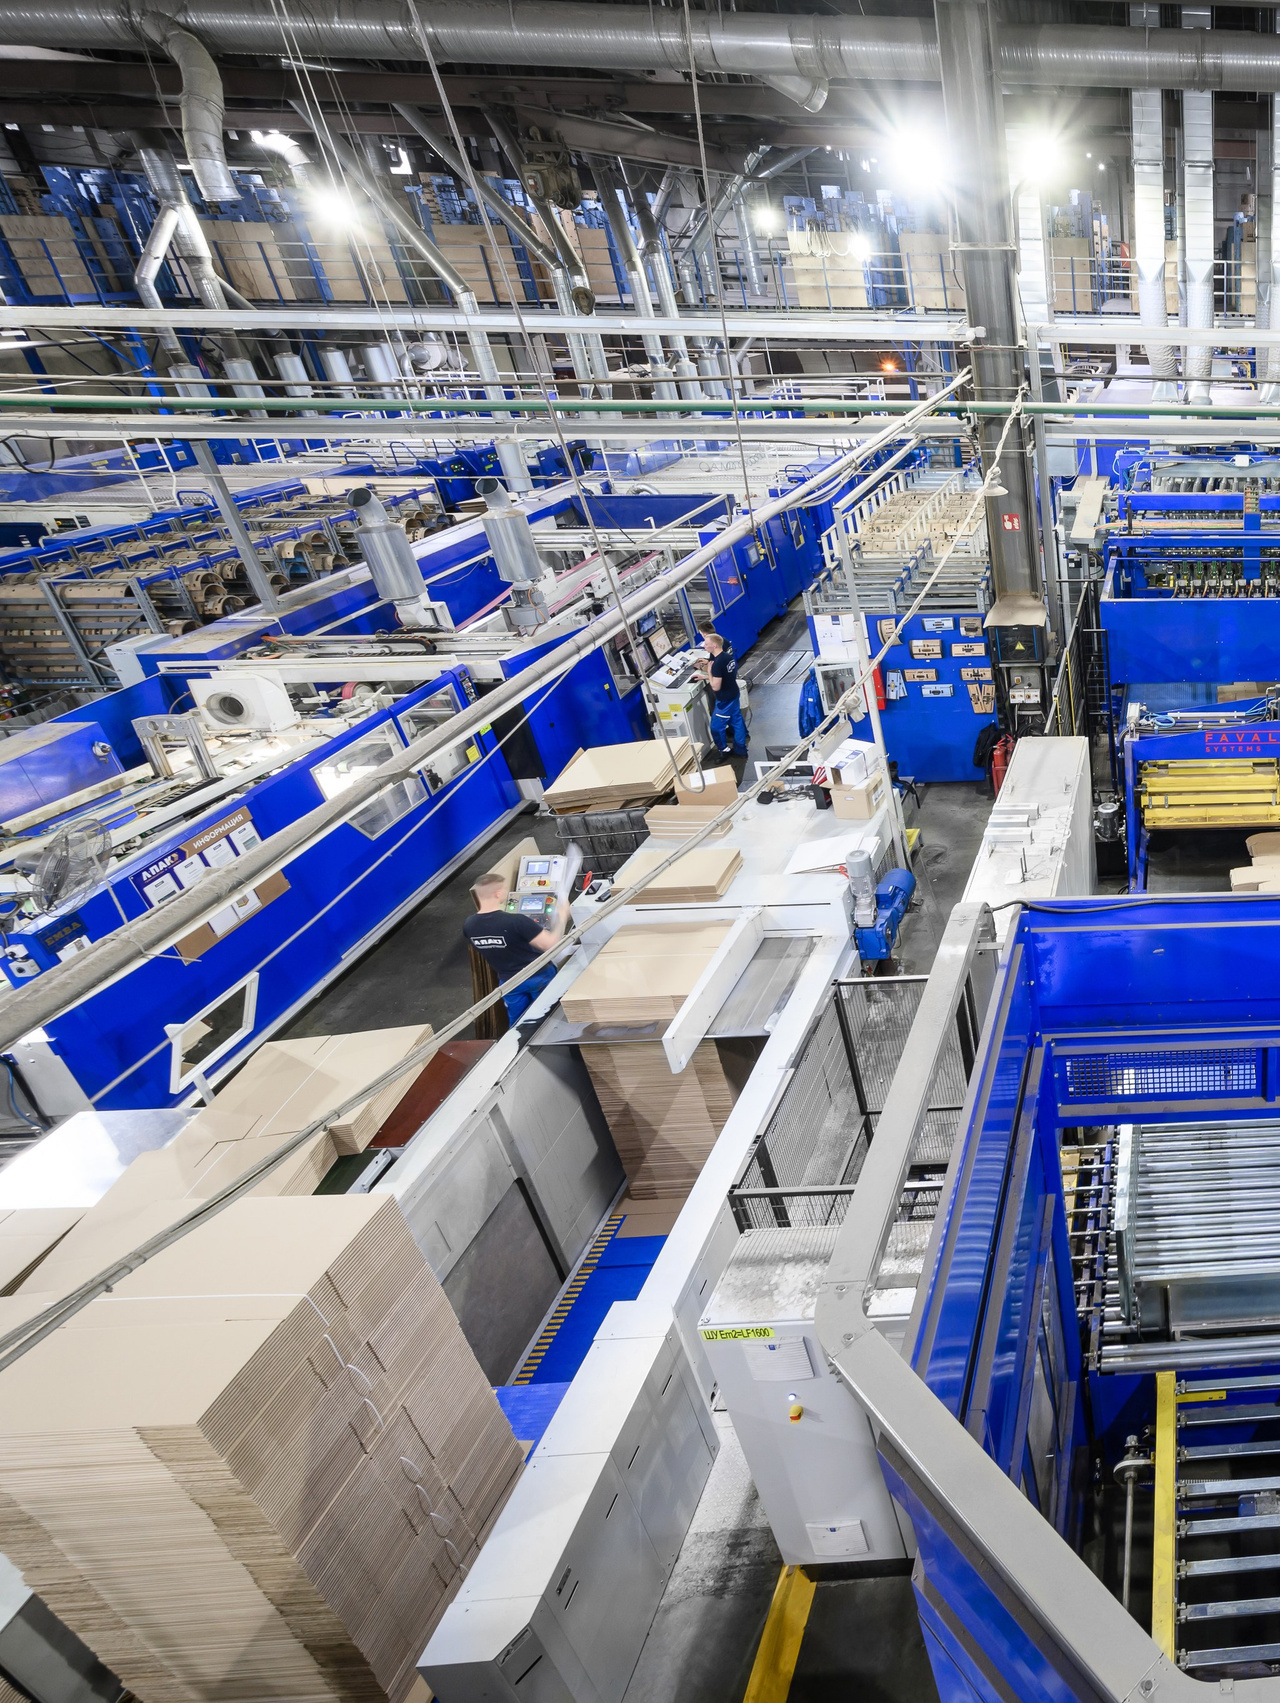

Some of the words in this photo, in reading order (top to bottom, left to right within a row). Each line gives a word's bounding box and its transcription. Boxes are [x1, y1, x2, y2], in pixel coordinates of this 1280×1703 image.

[1205, 745, 1262, 753] SYSTEMS
[192, 813, 244, 849] ИНФОРМАЦИЯ
[45, 921, 81, 946] EMBA
